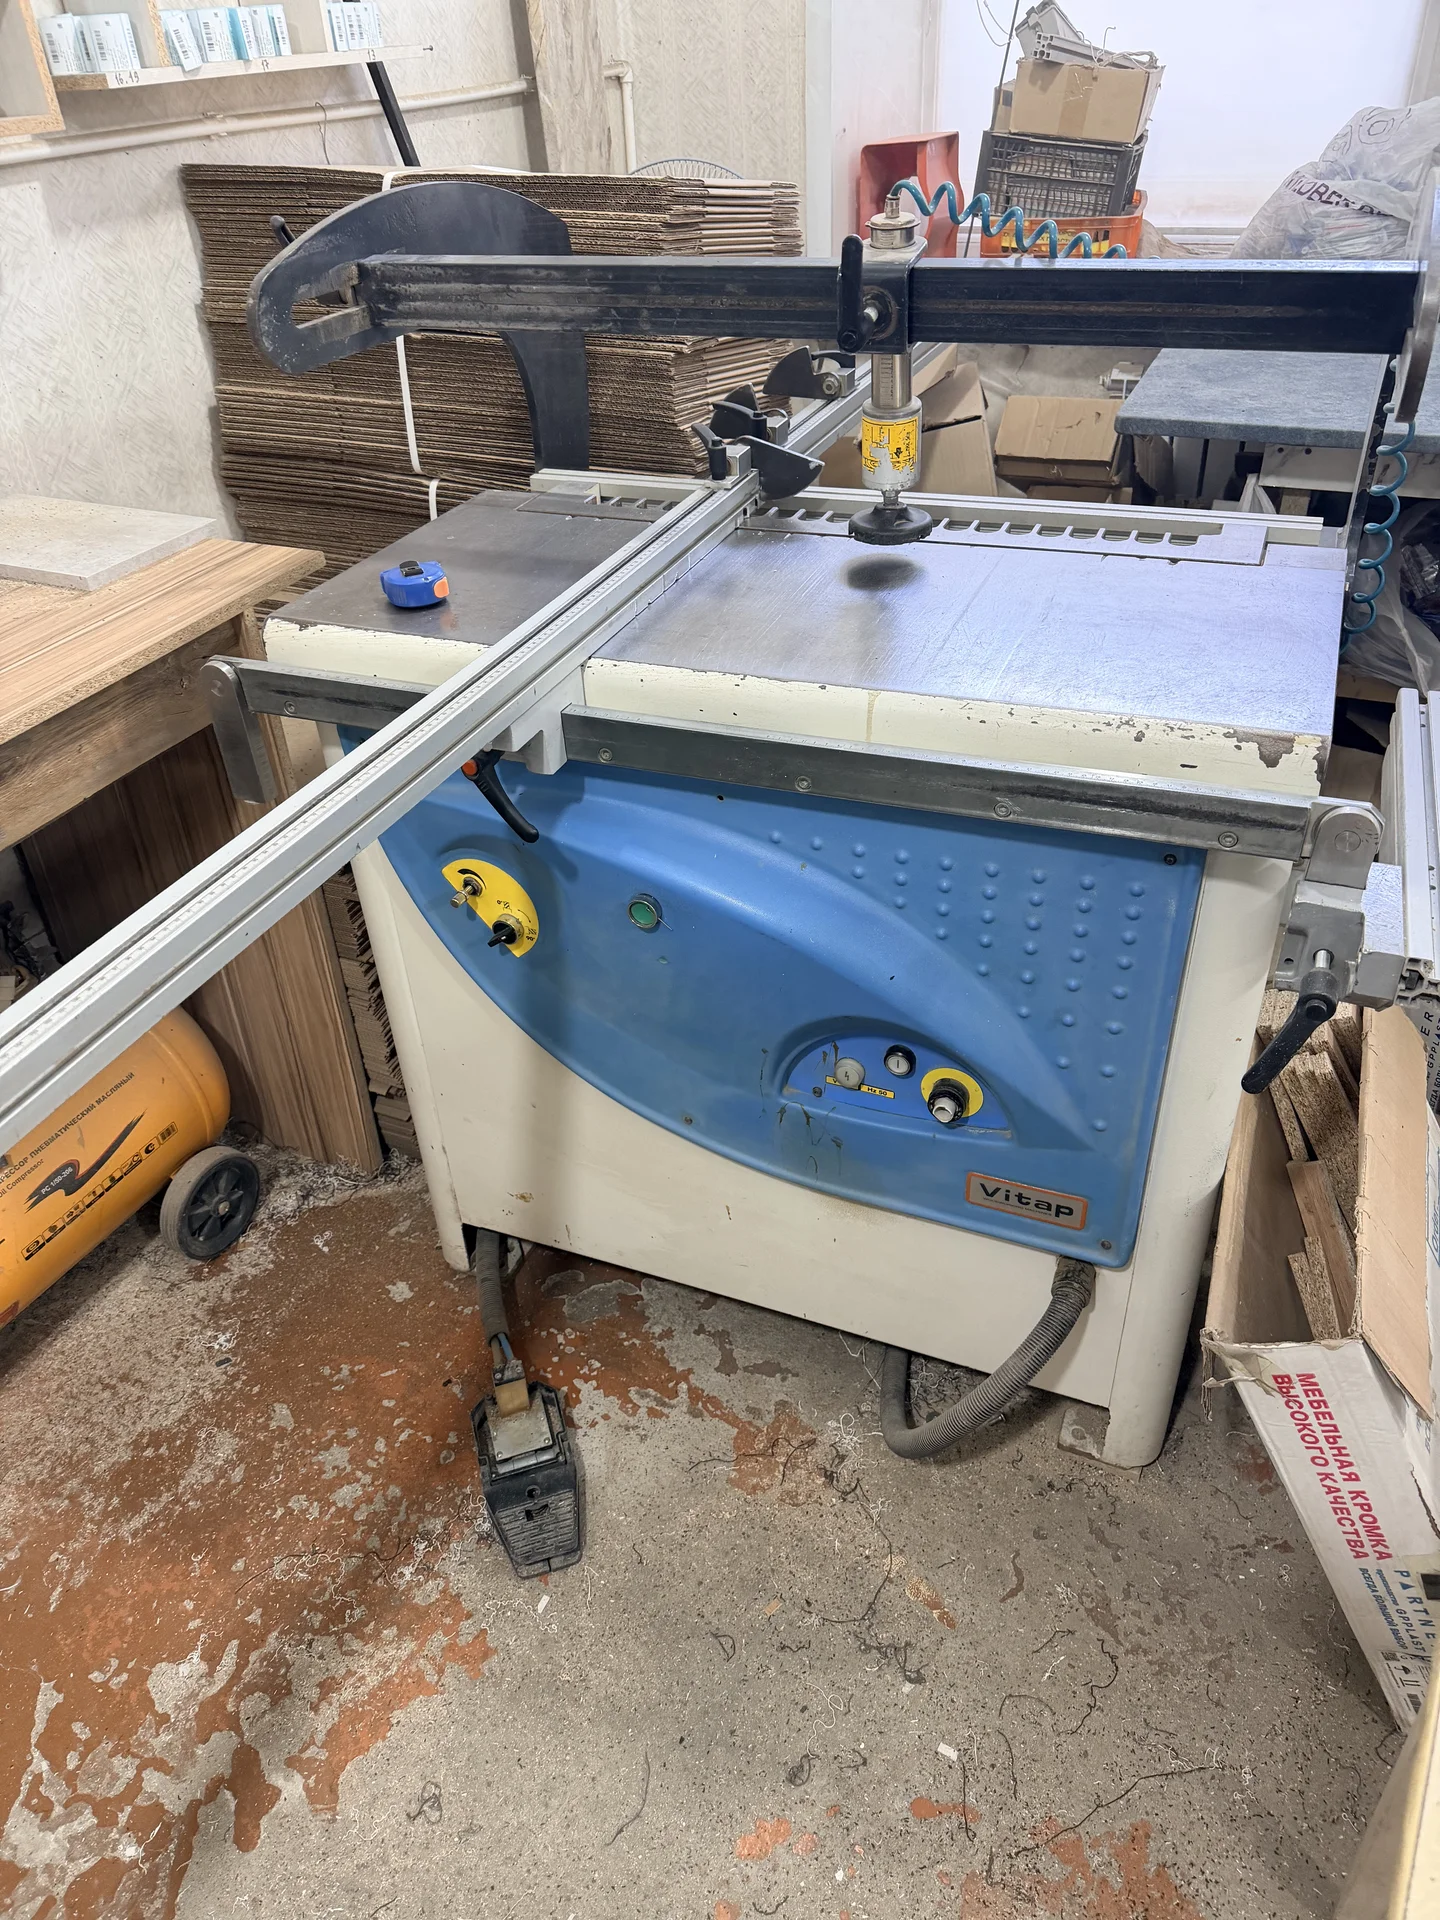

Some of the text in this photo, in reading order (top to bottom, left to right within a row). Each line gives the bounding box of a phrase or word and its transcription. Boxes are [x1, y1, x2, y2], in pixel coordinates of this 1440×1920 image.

[29, 1103, 97, 1159] ПНЕВМАТИЧЕСКИЙ
[95, 1072, 135, 1106] МАСЛЯНЫЙ
[41, 1184, 51, 1195] PC
[980, 1182, 1074, 1217] Vitap
[1272, 1374, 1369, 1559] ВЫСОКОГО КАЧЕСТВА
[1296, 1373, 1393, 1560] МЕБЕЛЬНАЯ КРОМКА
[1359, 1567, 1379, 1594] ВСЕГДА
[1373, 1594, 1397, 1629] БОЛЬШОЙ
[1389, 1626, 1408, 1650] ВЫБОР
[1394, 1570, 1436, 1647] PARTNE
[1396, 1608, 1426, 1653] GPPLAST
